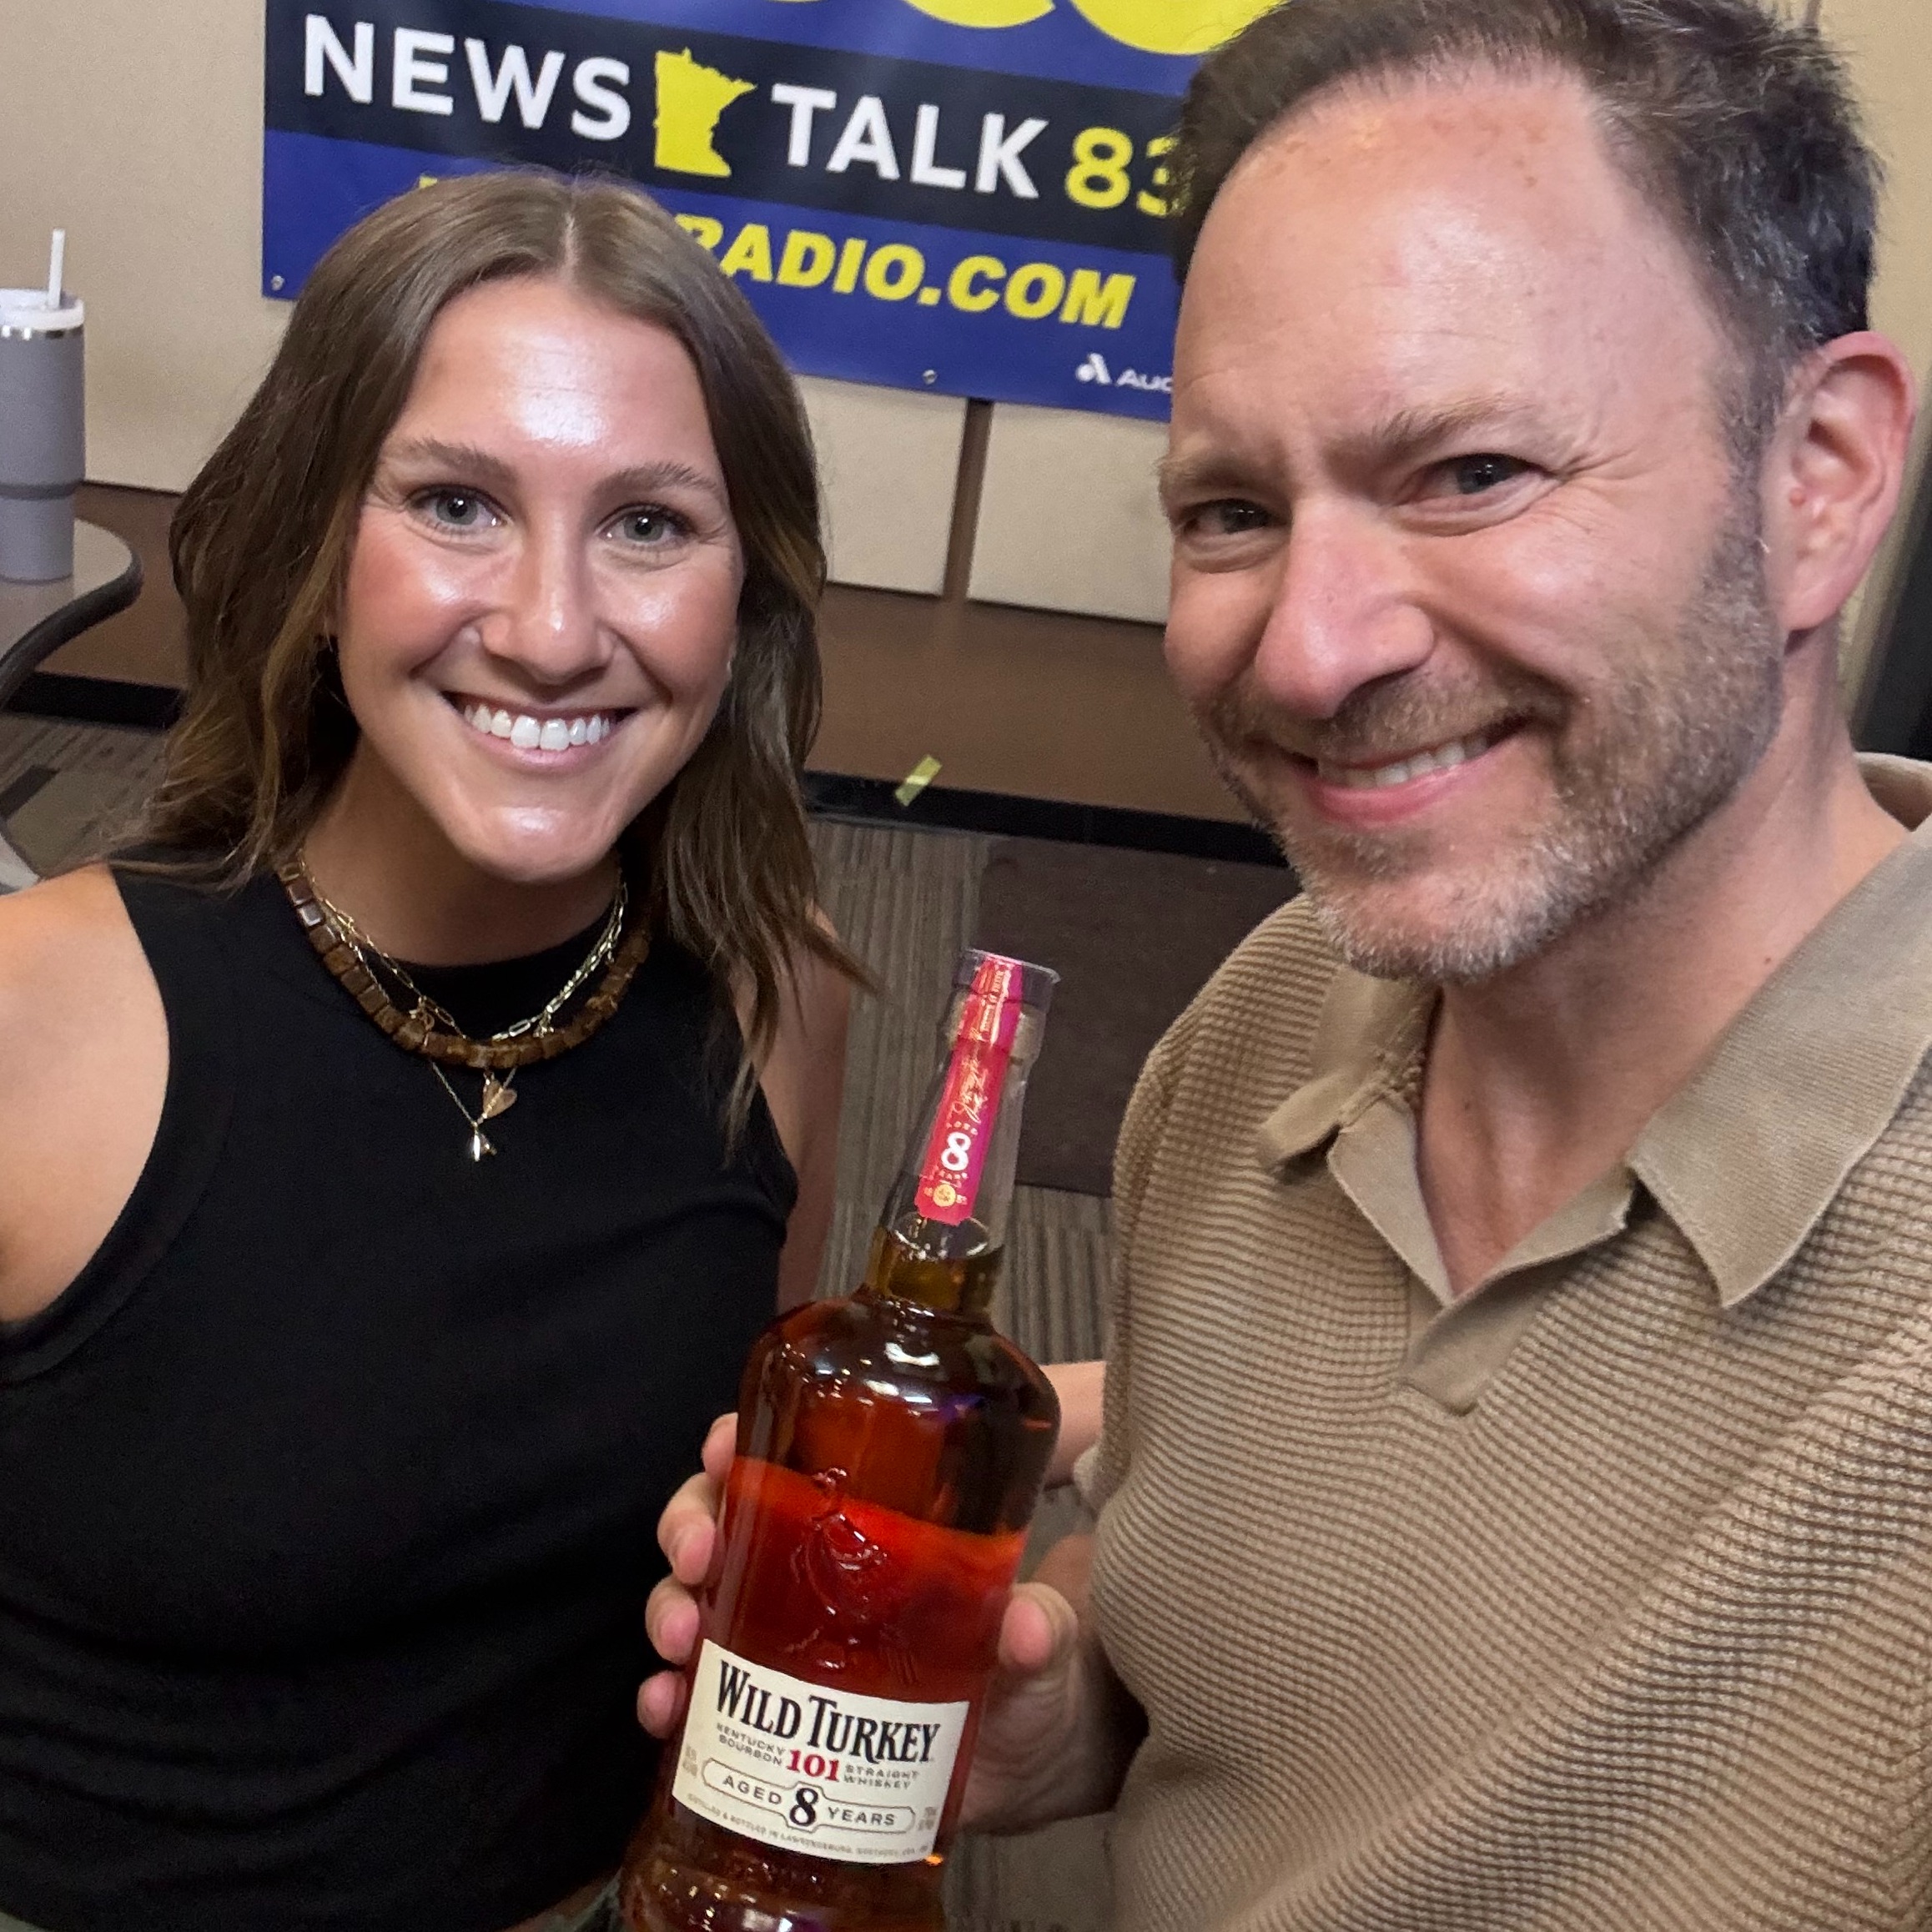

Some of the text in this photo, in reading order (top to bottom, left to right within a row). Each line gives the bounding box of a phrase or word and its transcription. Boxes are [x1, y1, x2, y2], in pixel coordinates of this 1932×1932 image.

[304, 13, 631, 140] NEWS
[771, 83, 1049, 199] TALK
[940, 1131, 971, 1171] 8
[716, 1658, 941, 1765] WILD TURKEY
[716, 1722, 919, 1779] KENTUCKY STRAIGHT
[718, 1733, 783, 1766] BOURBON
[843, 1774, 912, 1790] WHISKEY
[786, 1748, 841, 1784] 101
[722, 1774, 782, 1805] AGED
[788, 1787, 819, 1827] 8
[828, 1806, 895, 1826] YEARS
